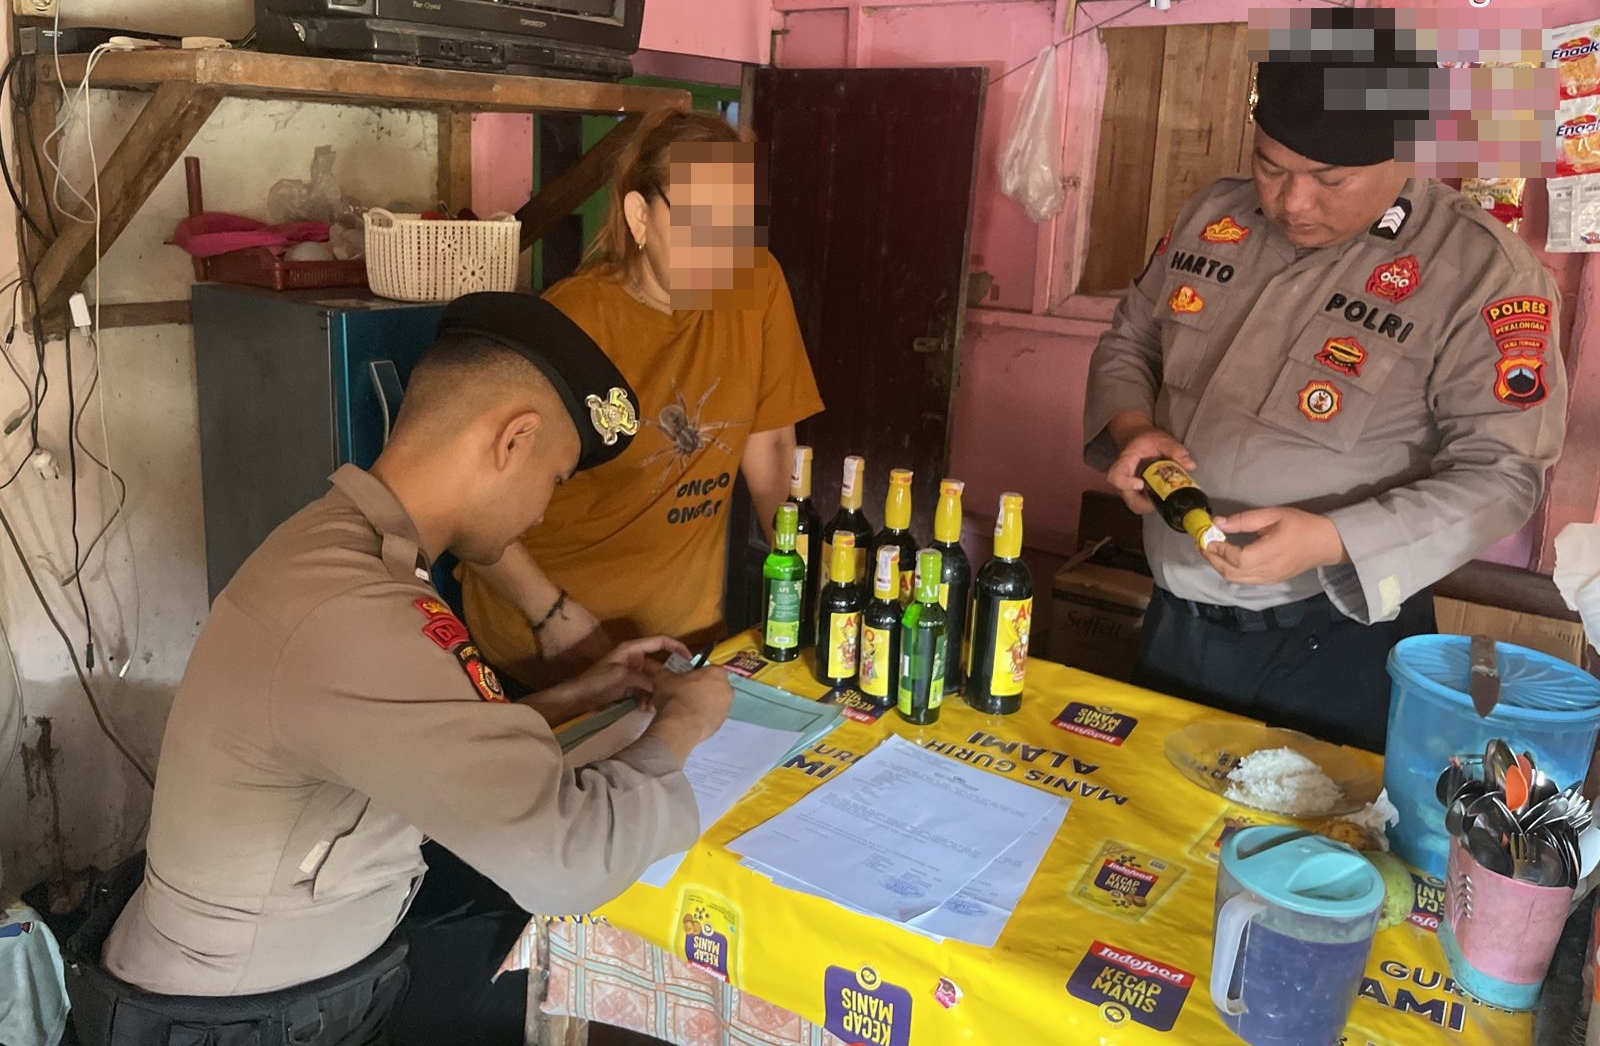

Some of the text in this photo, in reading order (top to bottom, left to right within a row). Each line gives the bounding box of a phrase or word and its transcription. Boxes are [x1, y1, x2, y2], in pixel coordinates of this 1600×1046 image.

[1551, 41, 1600, 60] Enaak
[1170, 251, 1235, 283] HARTO
[1325, 293, 1414, 343] POLRI
[1489, 300, 1547, 320] POLRES
[1495, 321, 1545, 335] PEKALONGAN
[835, 695, 876, 711] KECAP
[1074, 714, 1115, 733] KECAP
[1078, 708, 1121, 726] MANIS
[1057, 721, 1116, 743] Indofood
[966, 730, 1100, 775] ALAMI
[922, 739, 1129, 806] MANIS GURIH
[1108, 862, 1154, 881] Indofood
[1109, 872, 1140, 887] KECAP
[1104, 879, 1137, 894] MANIS
[693, 935, 720, 955] MANIS
[693, 948, 719, 967] KECAP
[1098, 946, 1185, 983] Indofood
[1100, 965, 1162, 998] KECAP
[1091, 976, 1157, 1013] MANIS
[841, 987, 894, 1025] MANIS
[843, 1010, 892, 1046] KECAP
